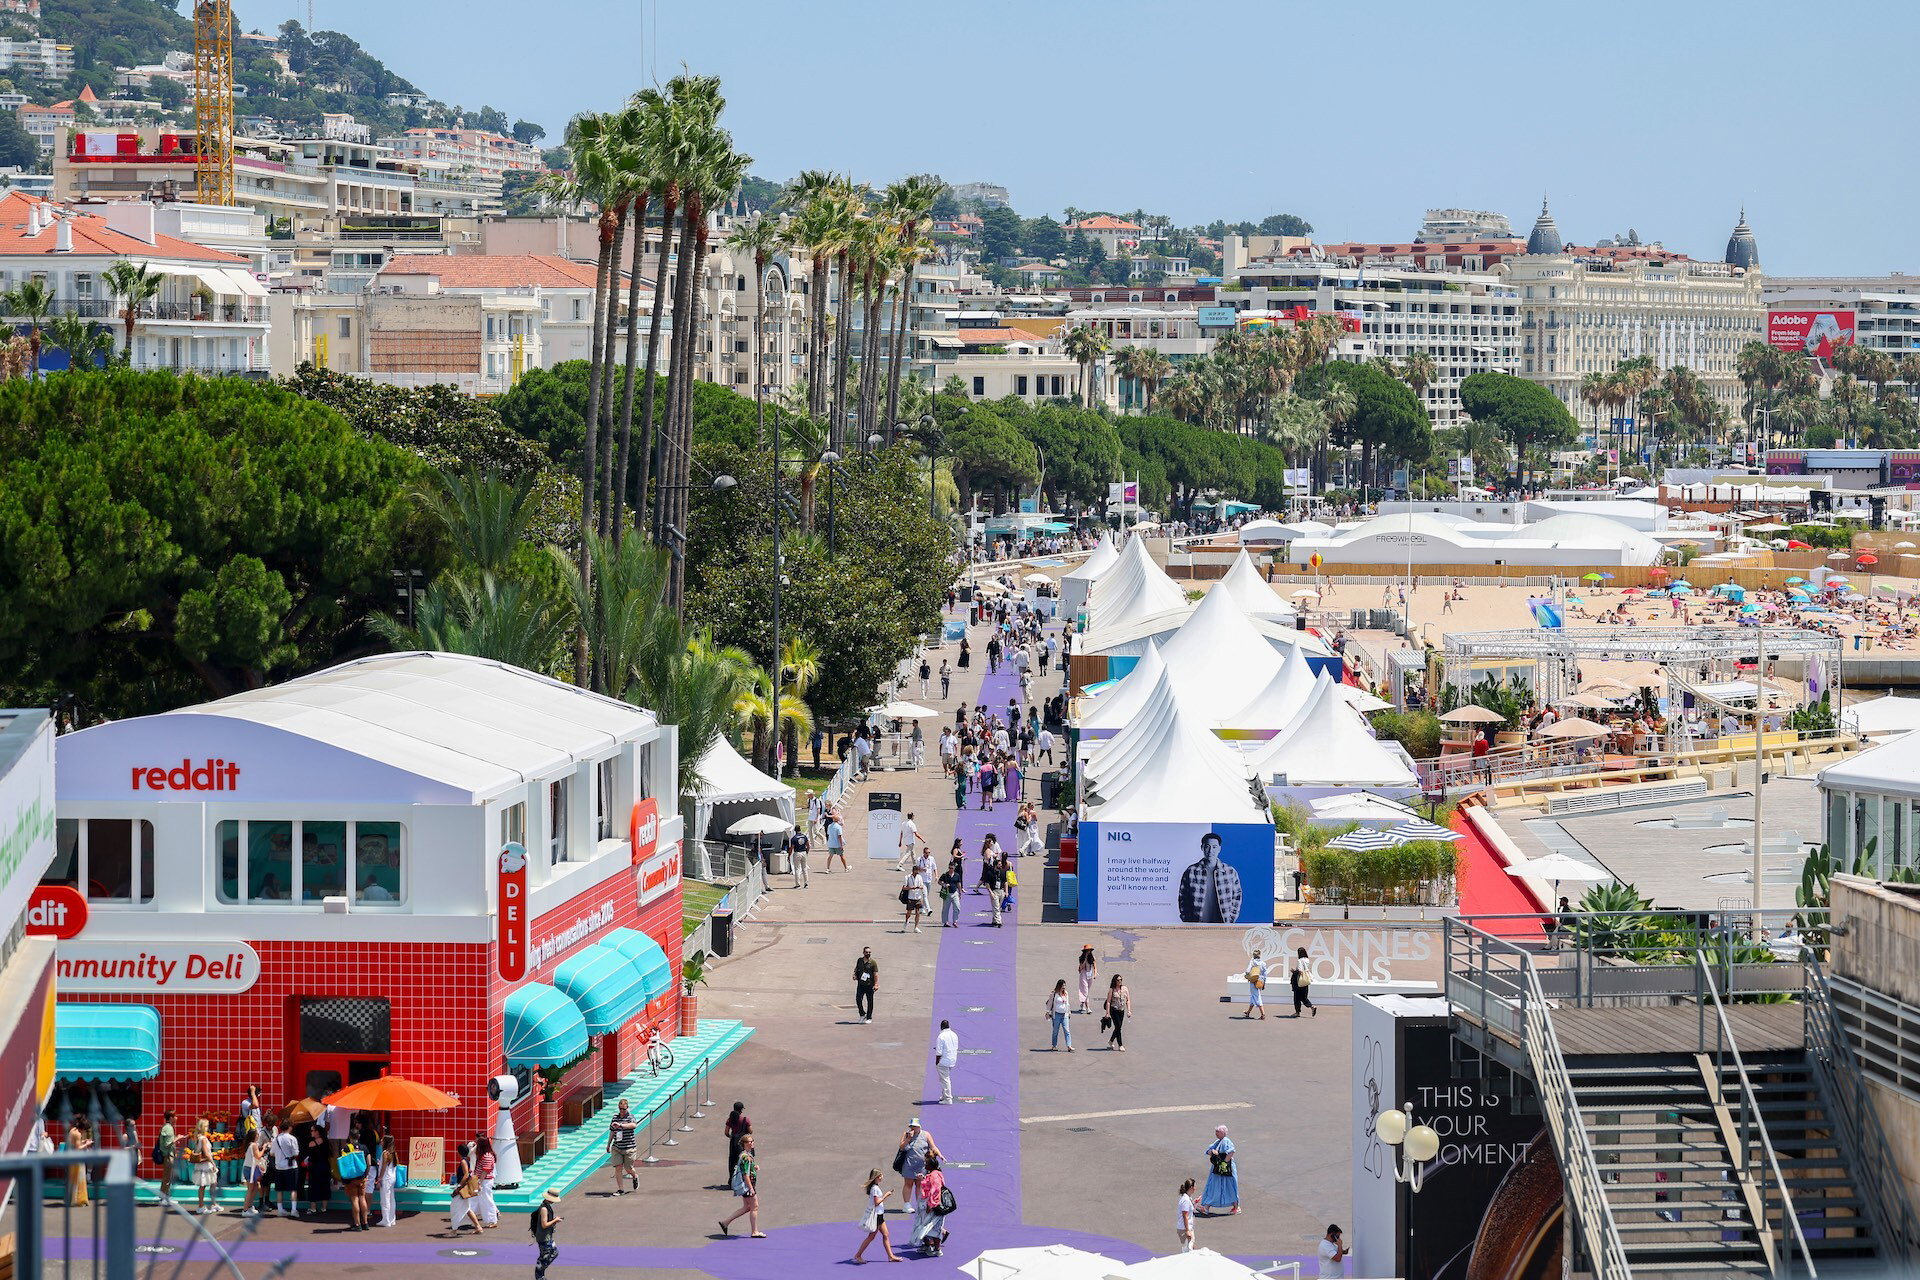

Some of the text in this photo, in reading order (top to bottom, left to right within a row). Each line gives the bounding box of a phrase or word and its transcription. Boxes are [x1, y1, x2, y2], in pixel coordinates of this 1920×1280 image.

[1771, 315, 1808, 325] Adobe
[131, 759, 240, 790] reddit
[1107, 832, 1132, 842] NIQ
[1142, 857, 1171, 866] halfway
[24, 899, 68, 926] dit
[506, 883, 520, 967] DELI
[1281, 927, 1431, 961] CANNES
[185, 954, 244, 979] Deli
[1282, 956, 1392, 983] LONS
[1417, 1086, 1473, 1107] THIS
[1418, 1115, 1489, 1136] YOUR
[412, 1148, 437, 1162] Daily
[415, 1140, 437, 1151] Open
